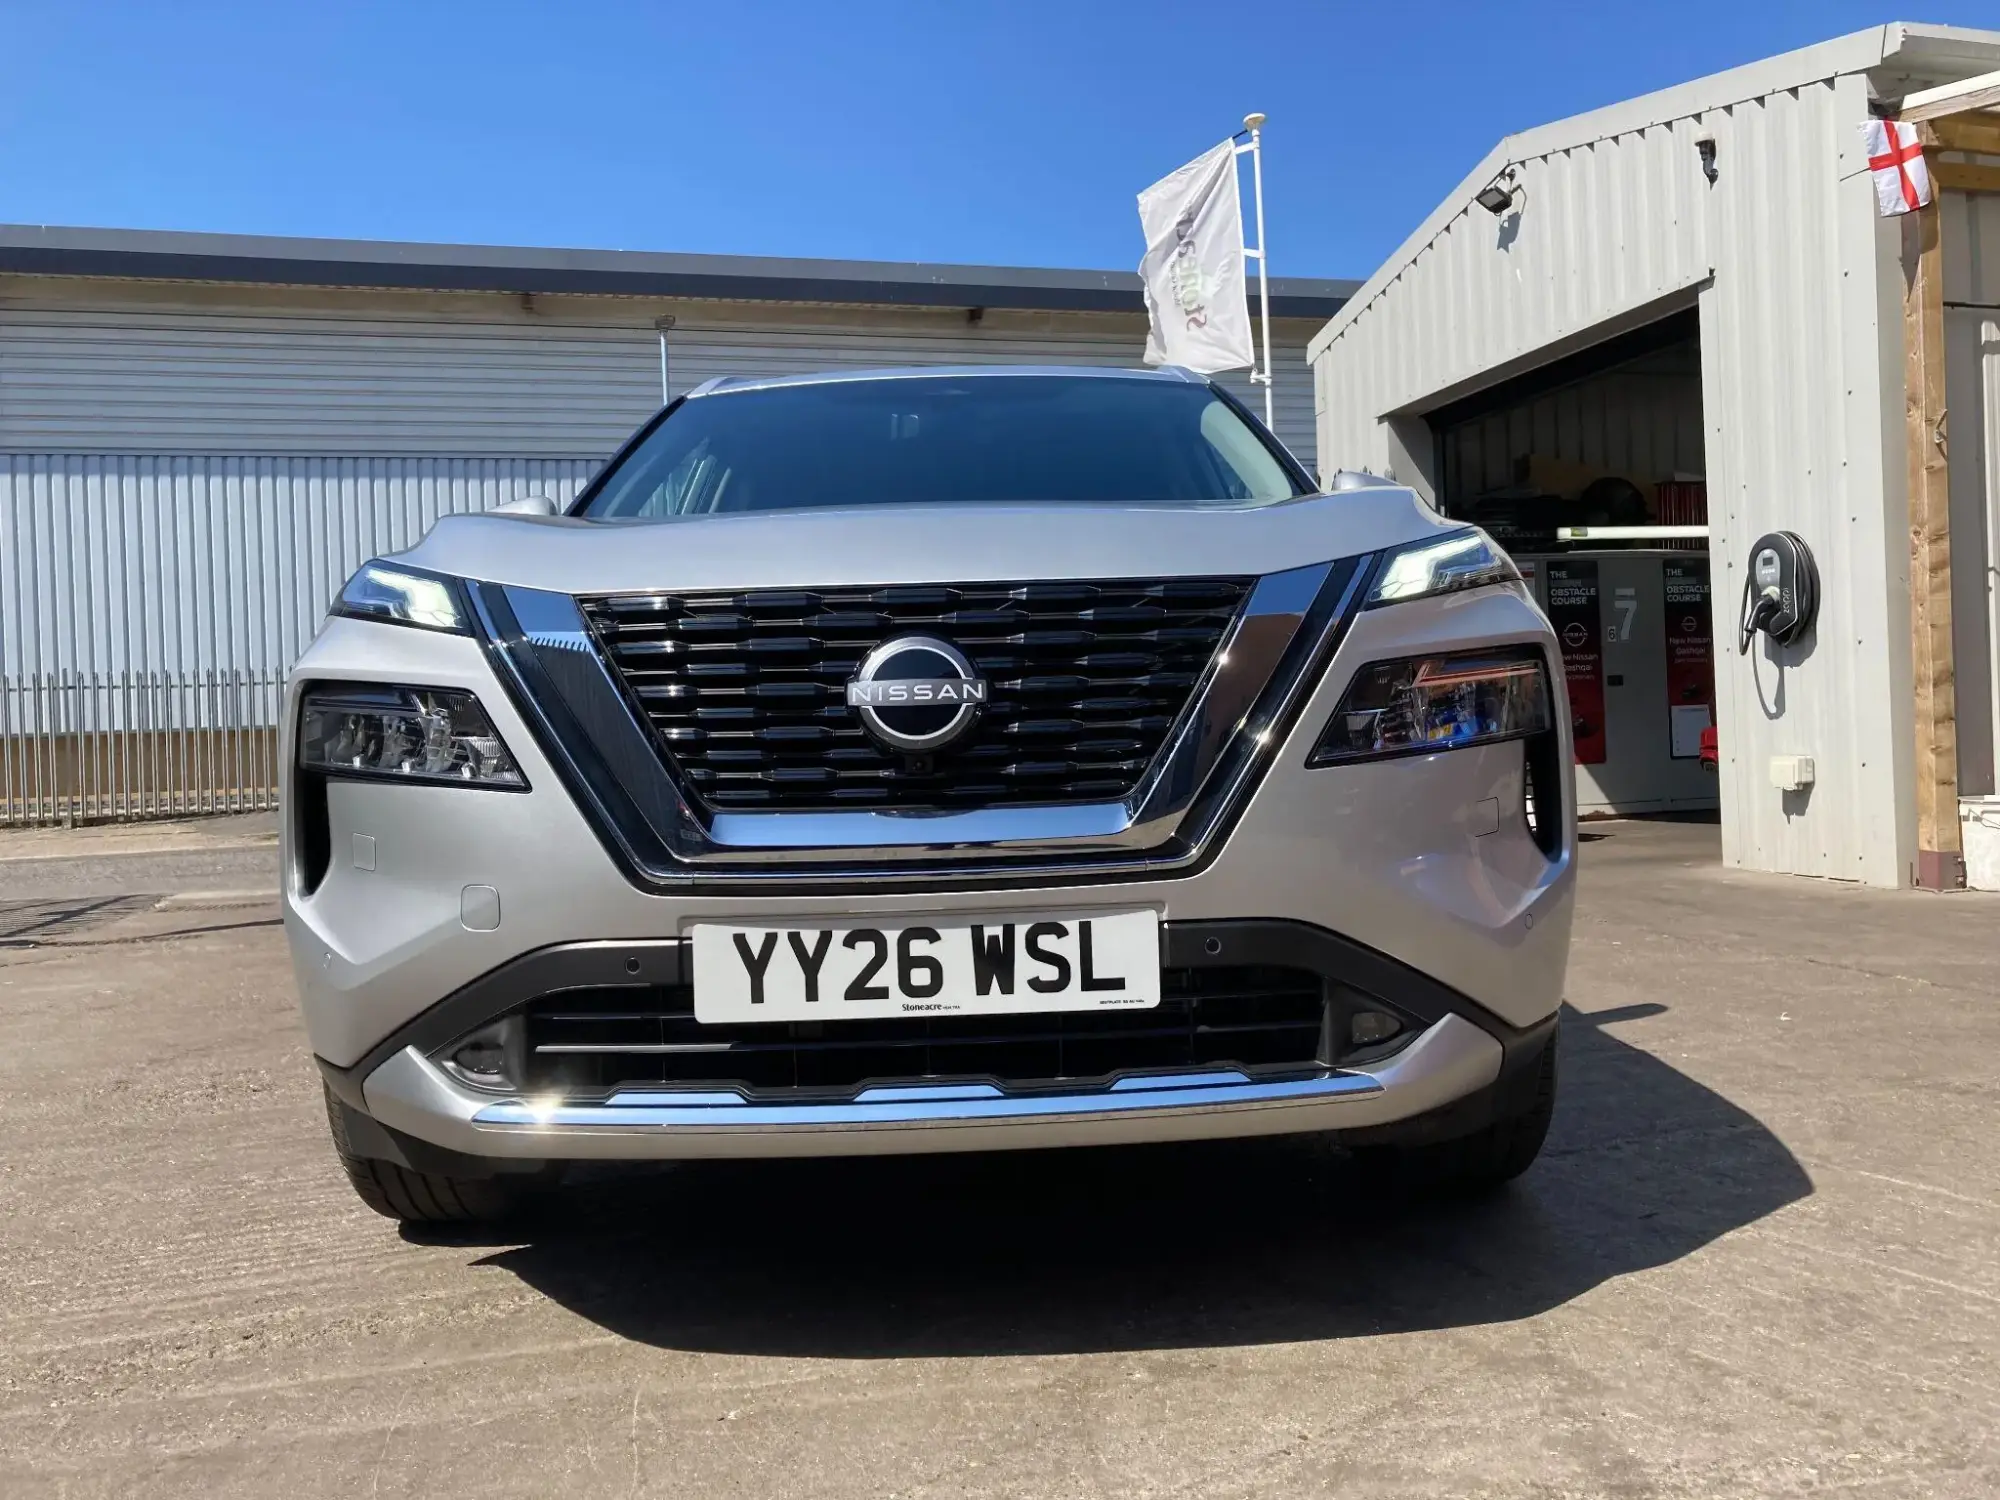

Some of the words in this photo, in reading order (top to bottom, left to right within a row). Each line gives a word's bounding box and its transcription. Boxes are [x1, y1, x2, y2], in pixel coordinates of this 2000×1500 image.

[1550, 571, 1568, 579] THE
[1550, 588, 1596, 596] OBSTACLE
[1666, 585, 1710, 594] OBSTACLE
[1551, 597, 1588, 605] COURSE
[1667, 594, 1702, 602] COURSE
[1608, 628, 1616, 640] 6
[851, 682, 983, 703] NISSAN
[732, 925, 944, 1004] YY26
[969, 919, 1126, 996] WSL
[902, 1003, 942, 1011] Stoneacre
